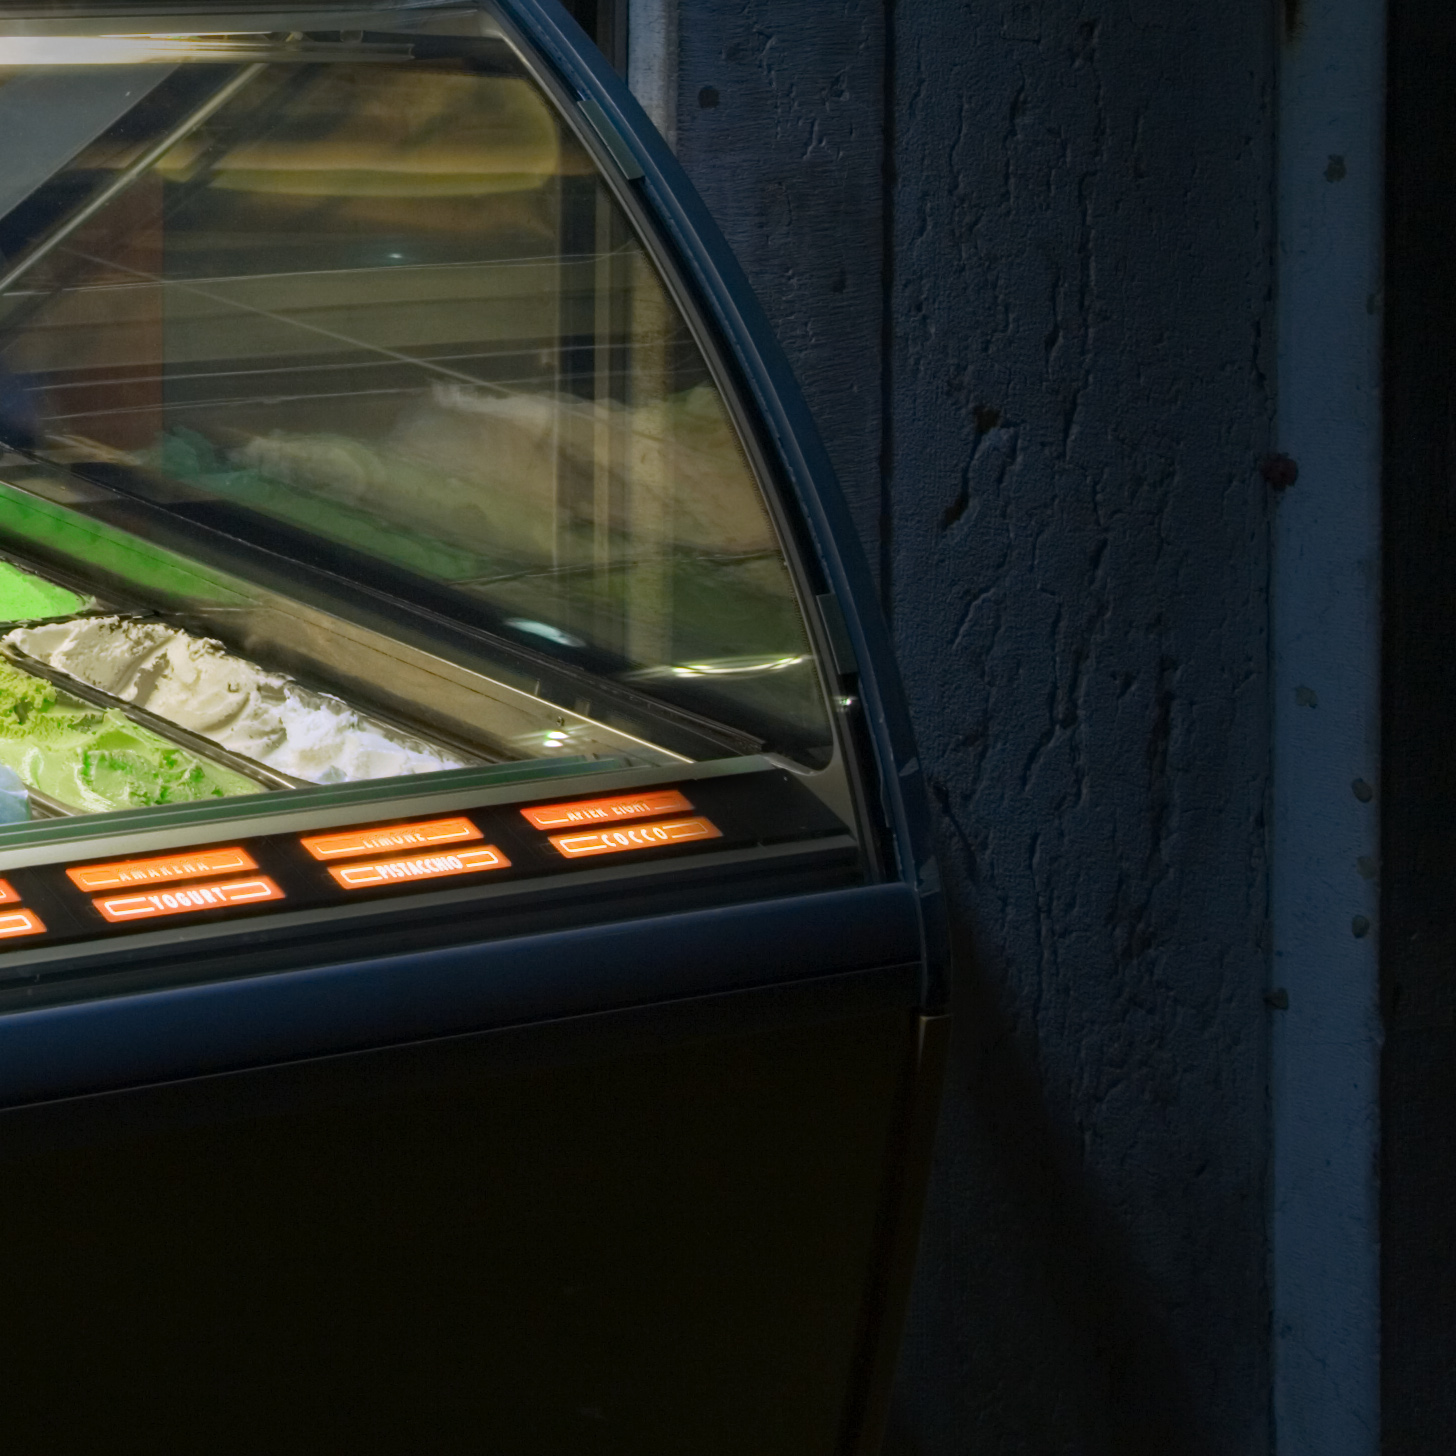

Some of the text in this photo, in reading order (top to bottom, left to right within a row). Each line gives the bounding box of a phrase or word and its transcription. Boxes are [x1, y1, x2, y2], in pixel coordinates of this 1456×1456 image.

[601, 827, 668, 847] COCCO
[374, 856, 463, 880] PISTACCHIO
[148, 887, 227, 910] YOGURT
